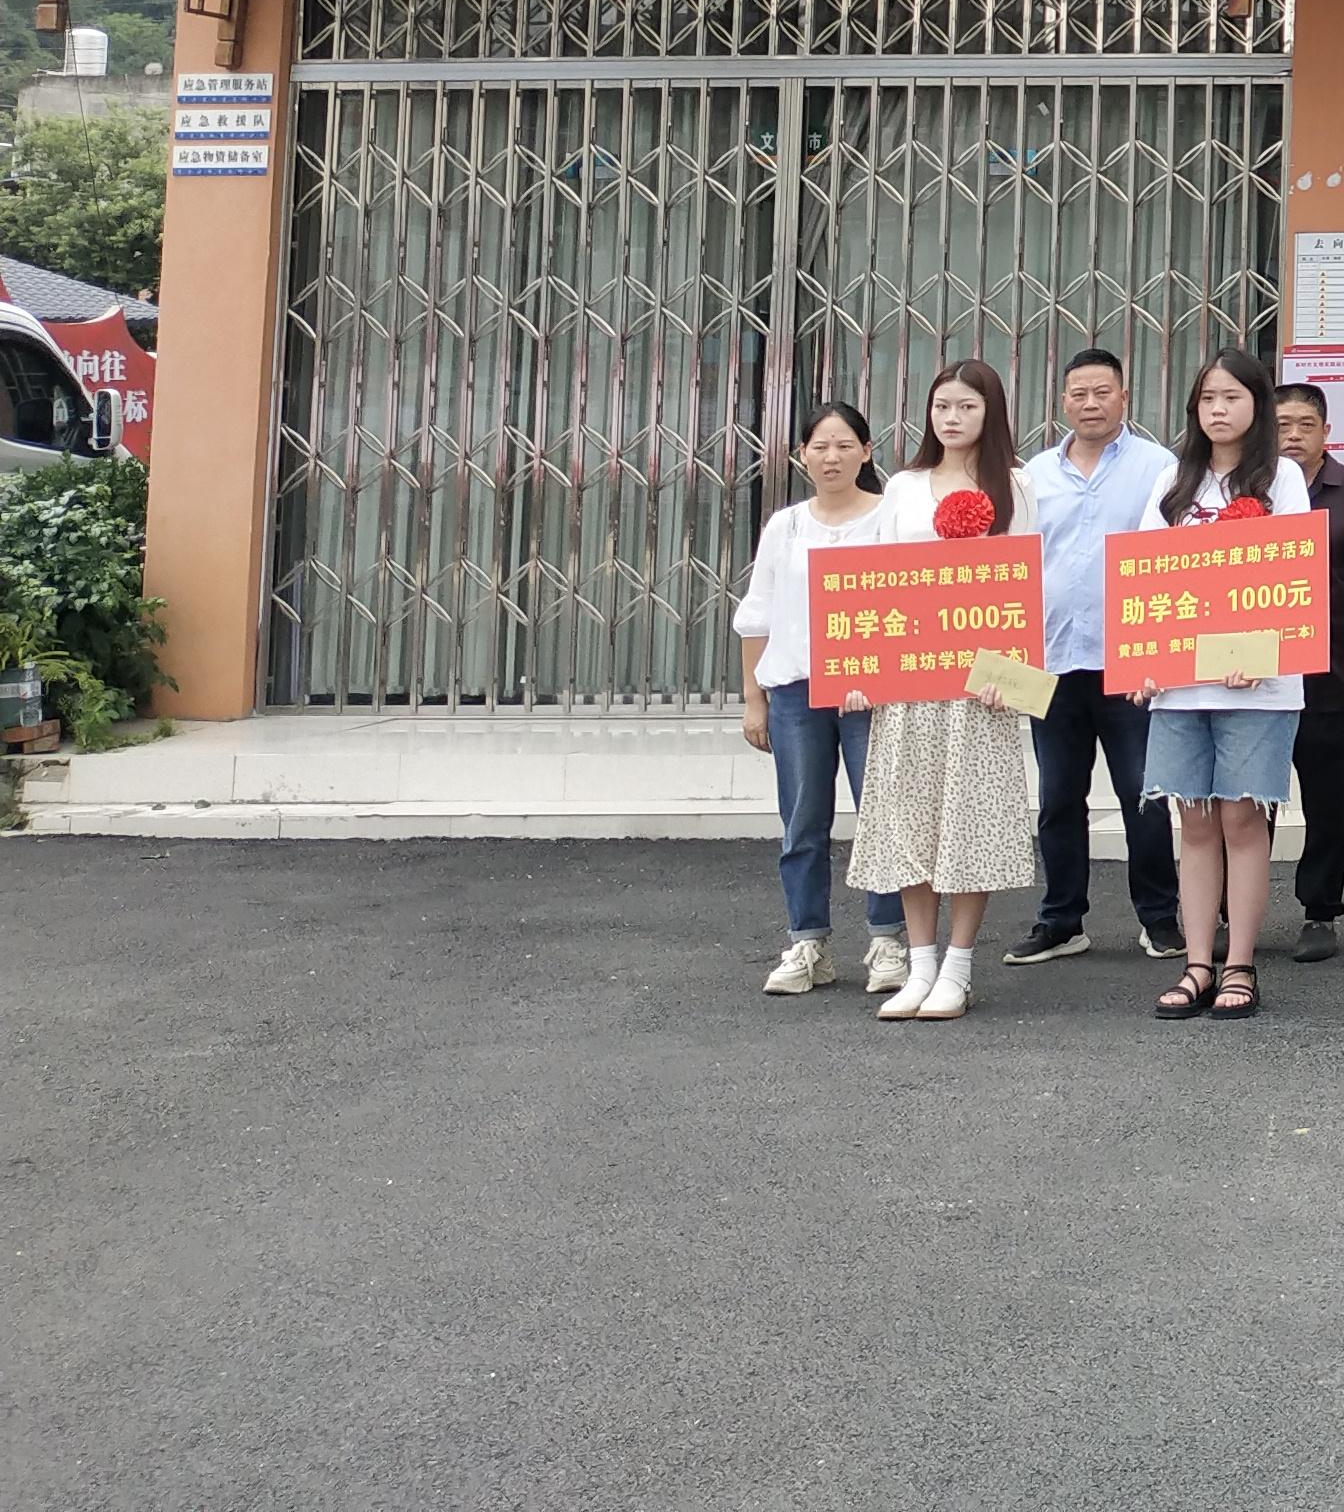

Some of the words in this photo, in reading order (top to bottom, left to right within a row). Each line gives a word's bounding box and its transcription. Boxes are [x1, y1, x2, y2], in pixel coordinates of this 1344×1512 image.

[823, 561, 1028, 592] 硐口村2023年度助学活动
[1119, 538, 1315, 577] 硐口村2023年度助学活动
[825, 602, 1027, 641] 助学金：1000元
[1120, 579, 1312, 626] 助学金：1000元
[900, 646, 1029, 674] 潍坊学院本)
